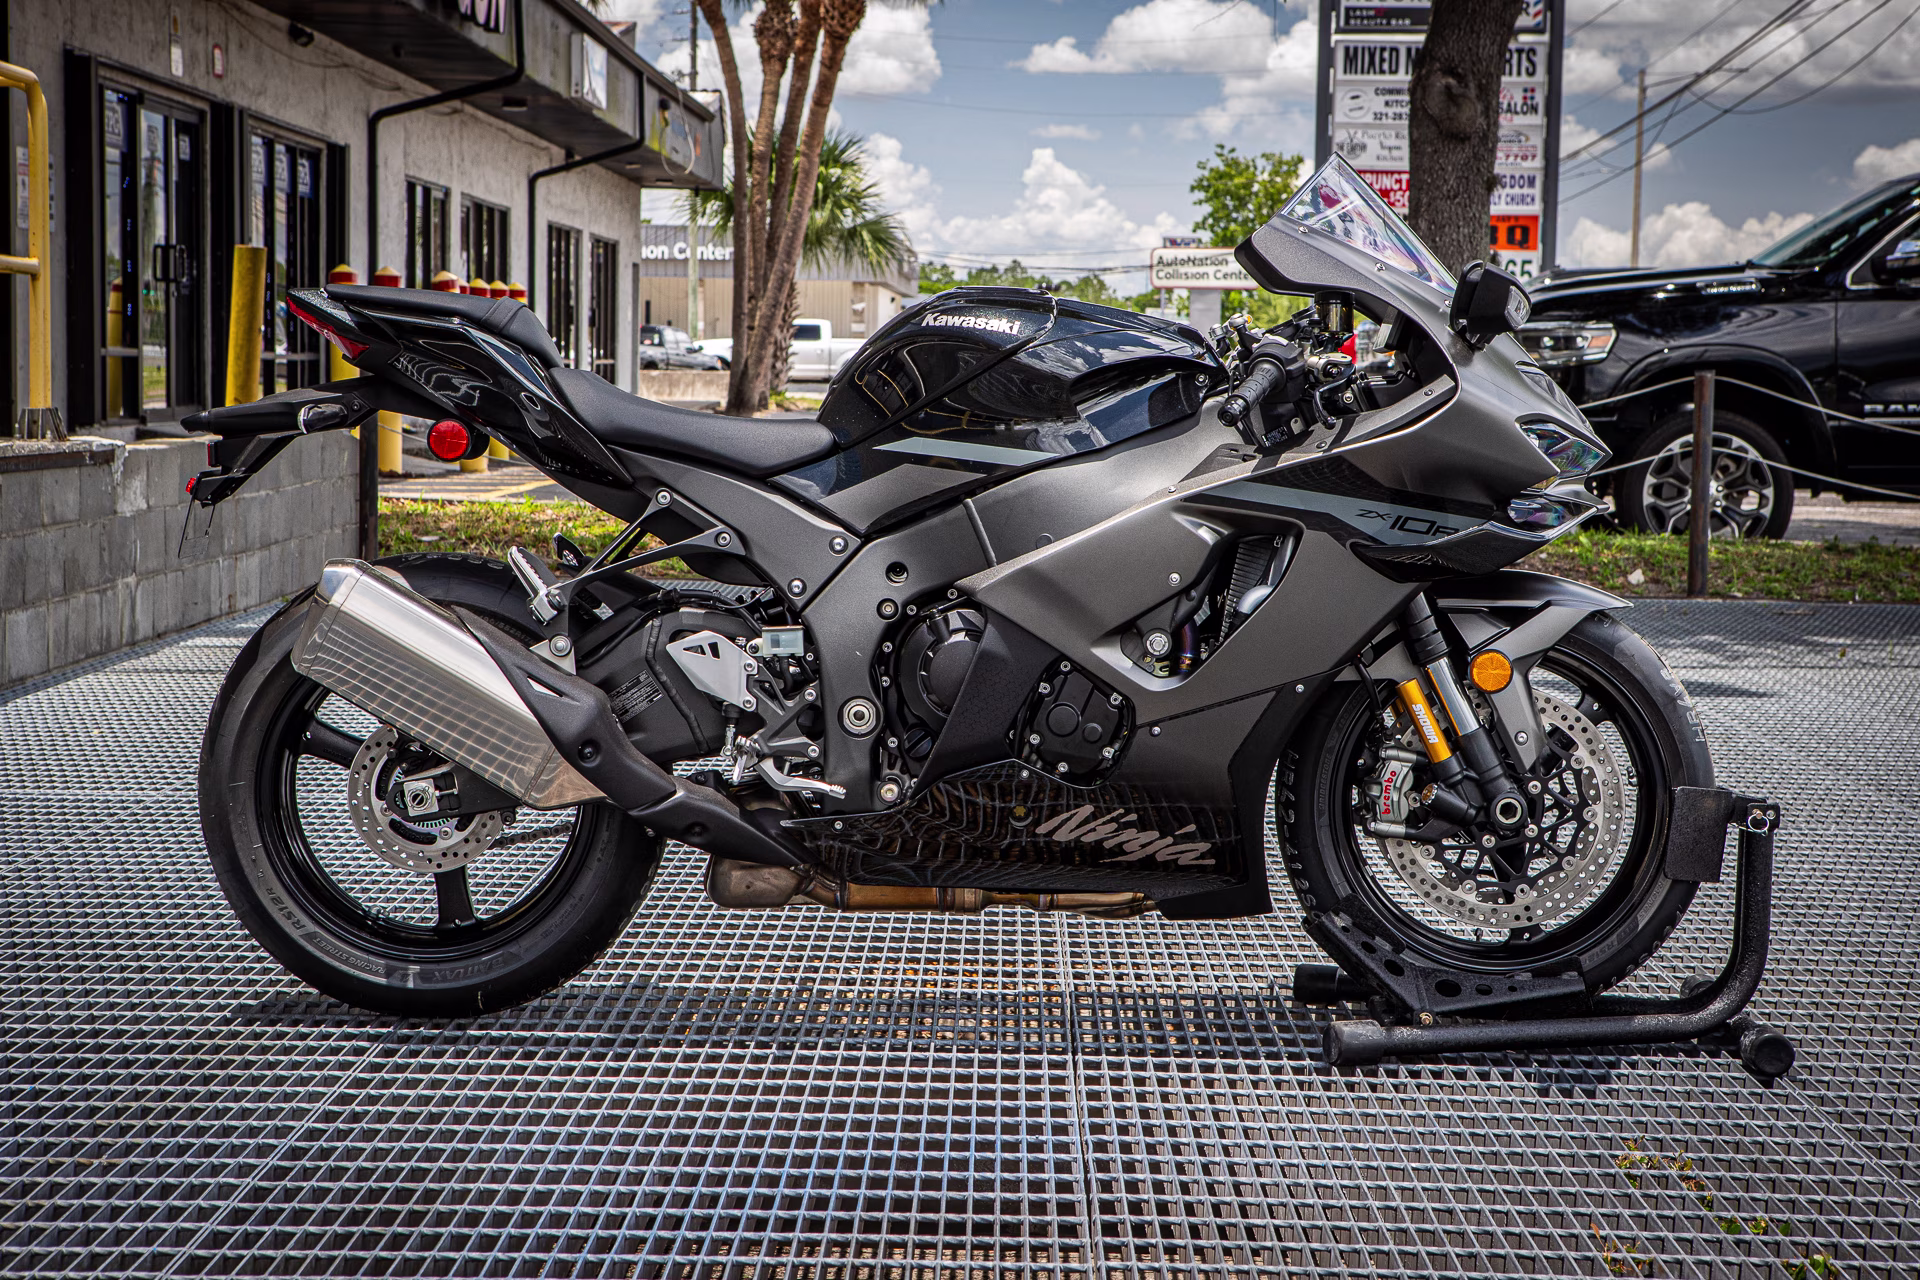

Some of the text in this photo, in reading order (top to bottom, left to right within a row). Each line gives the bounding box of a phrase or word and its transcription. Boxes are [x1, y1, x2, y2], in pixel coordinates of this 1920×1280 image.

[1349, 18, 1411, 26] BEAUTY BAR
[1343, 46, 1399, 76] MIXED
[1503, 47, 1537, 77] RTS
[1505, 193, 1535, 206] CHURCH
[1156, 255, 1228, 267] AutoNation
[1156, 269, 1250, 280] Collision Cente
[921, 312, 1020, 336] Kawasaki
[1412, 703, 1439, 744] SHOWA
[1381, 770, 1397, 815] brembo
[1035, 804, 1216, 866] Ninja
[312, 937, 387, 975] RACING STREET
